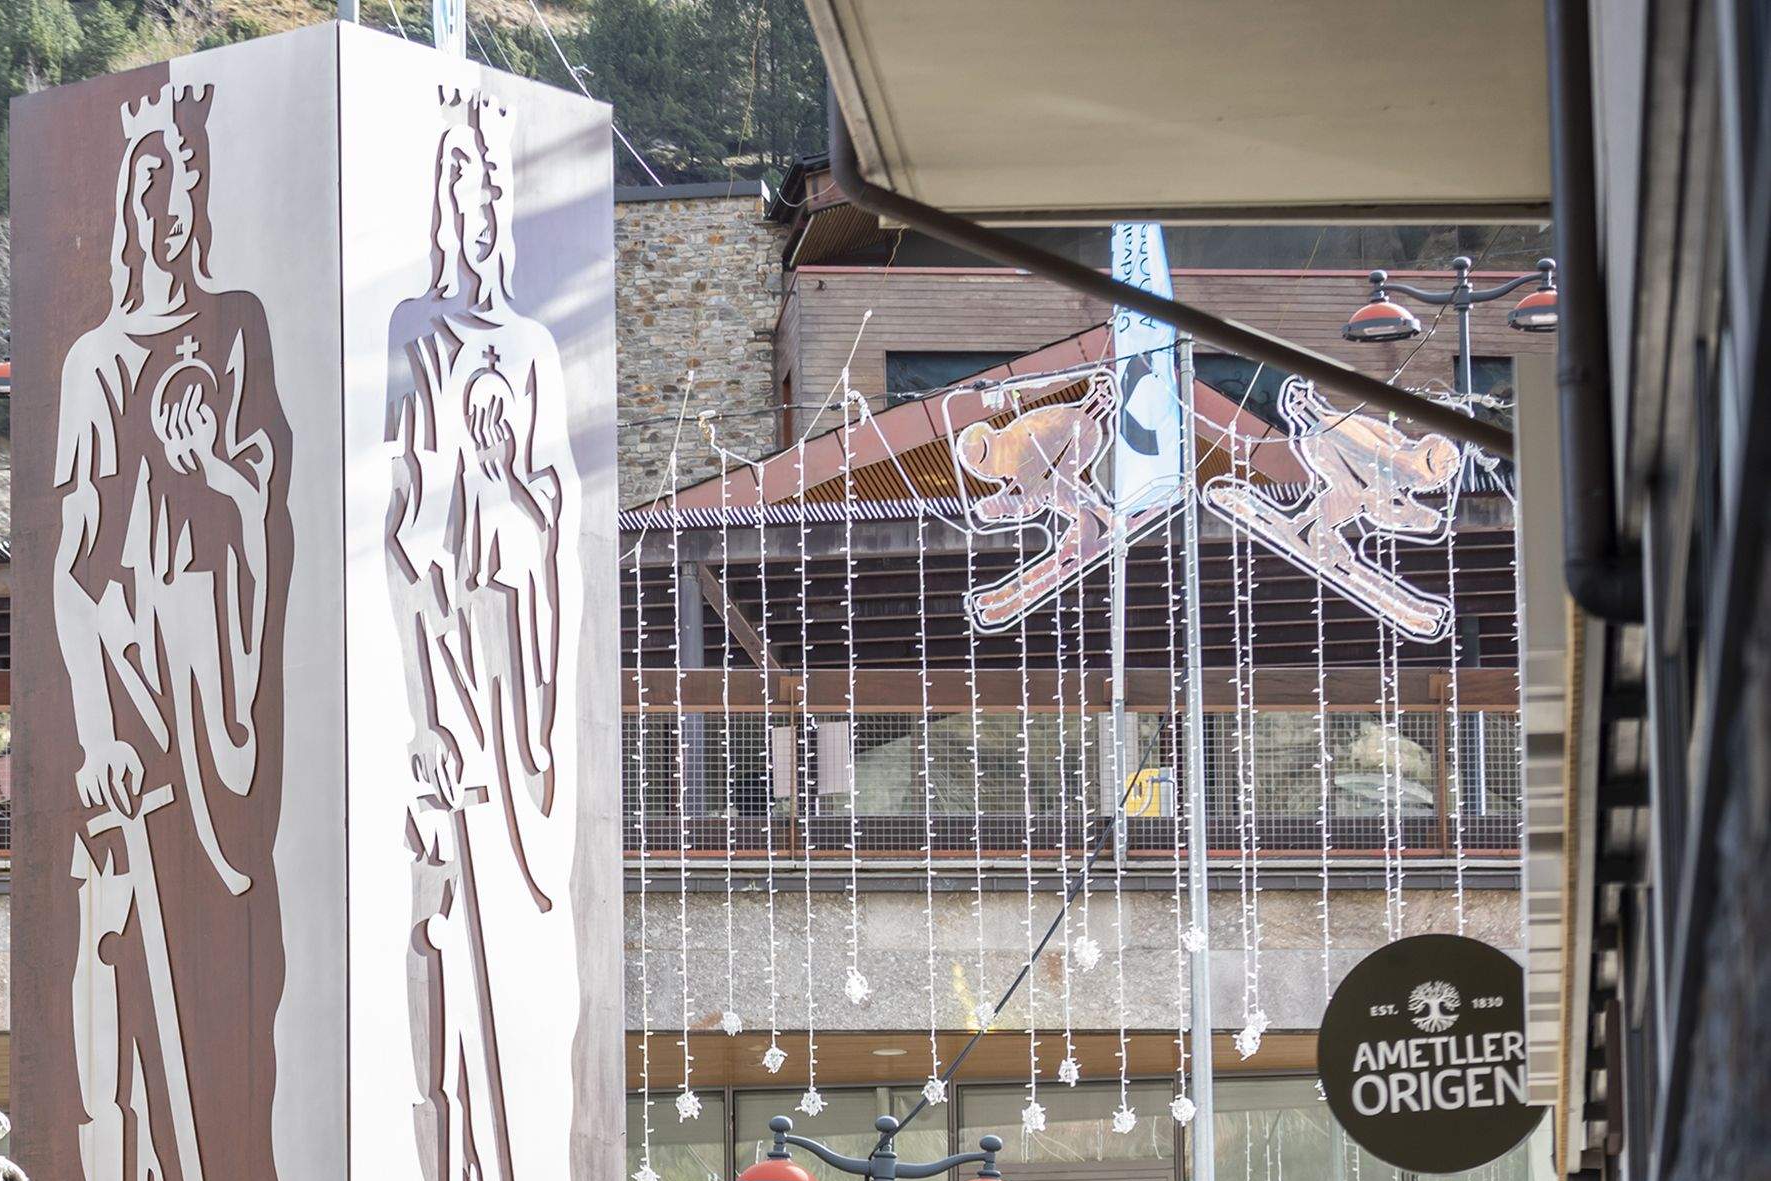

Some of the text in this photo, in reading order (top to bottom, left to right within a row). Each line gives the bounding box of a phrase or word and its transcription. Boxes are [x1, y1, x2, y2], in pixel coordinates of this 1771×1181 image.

[1369, 995, 1504, 1017] EST. 1830
[1352, 1031, 1526, 1073] AMETLLER
[1351, 1064, 1528, 1117] ORIGEN
